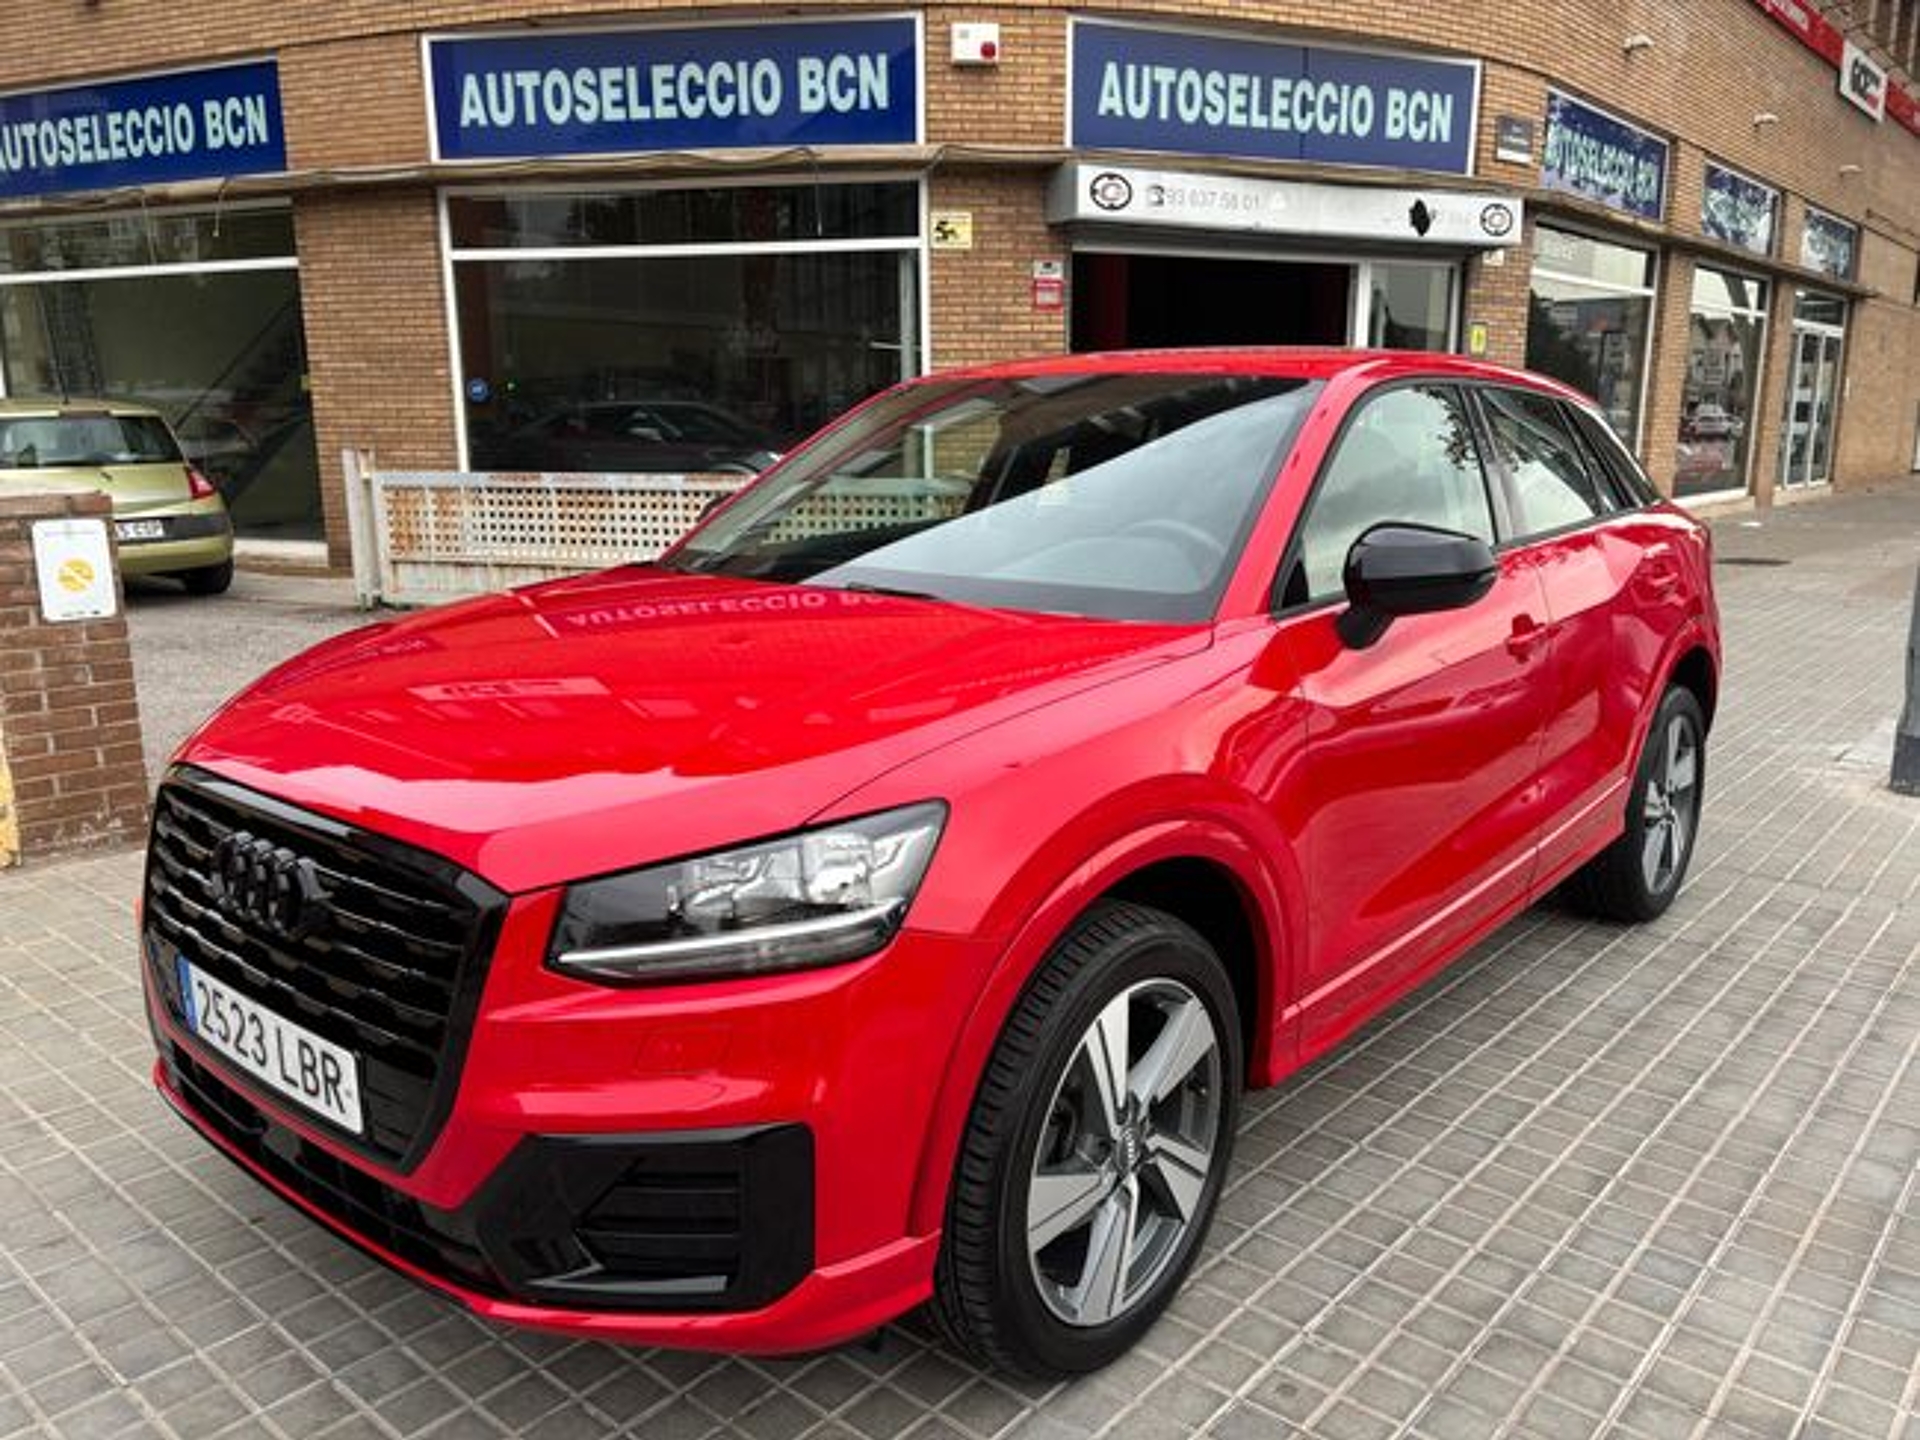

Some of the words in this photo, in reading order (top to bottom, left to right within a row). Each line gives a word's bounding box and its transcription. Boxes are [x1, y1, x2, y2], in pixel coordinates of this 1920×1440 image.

[203, 94, 269, 150] BCN
[460, 59, 783, 128] AUTOSELECCIO
[799, 53, 890, 113] BCN
[1098, 61, 1375, 137] AUTOSELECCIO
[1385, 87, 1453, 143] BCN
[197, 980, 267, 1067] 2523
[276, 1026, 346, 1114] LBR
